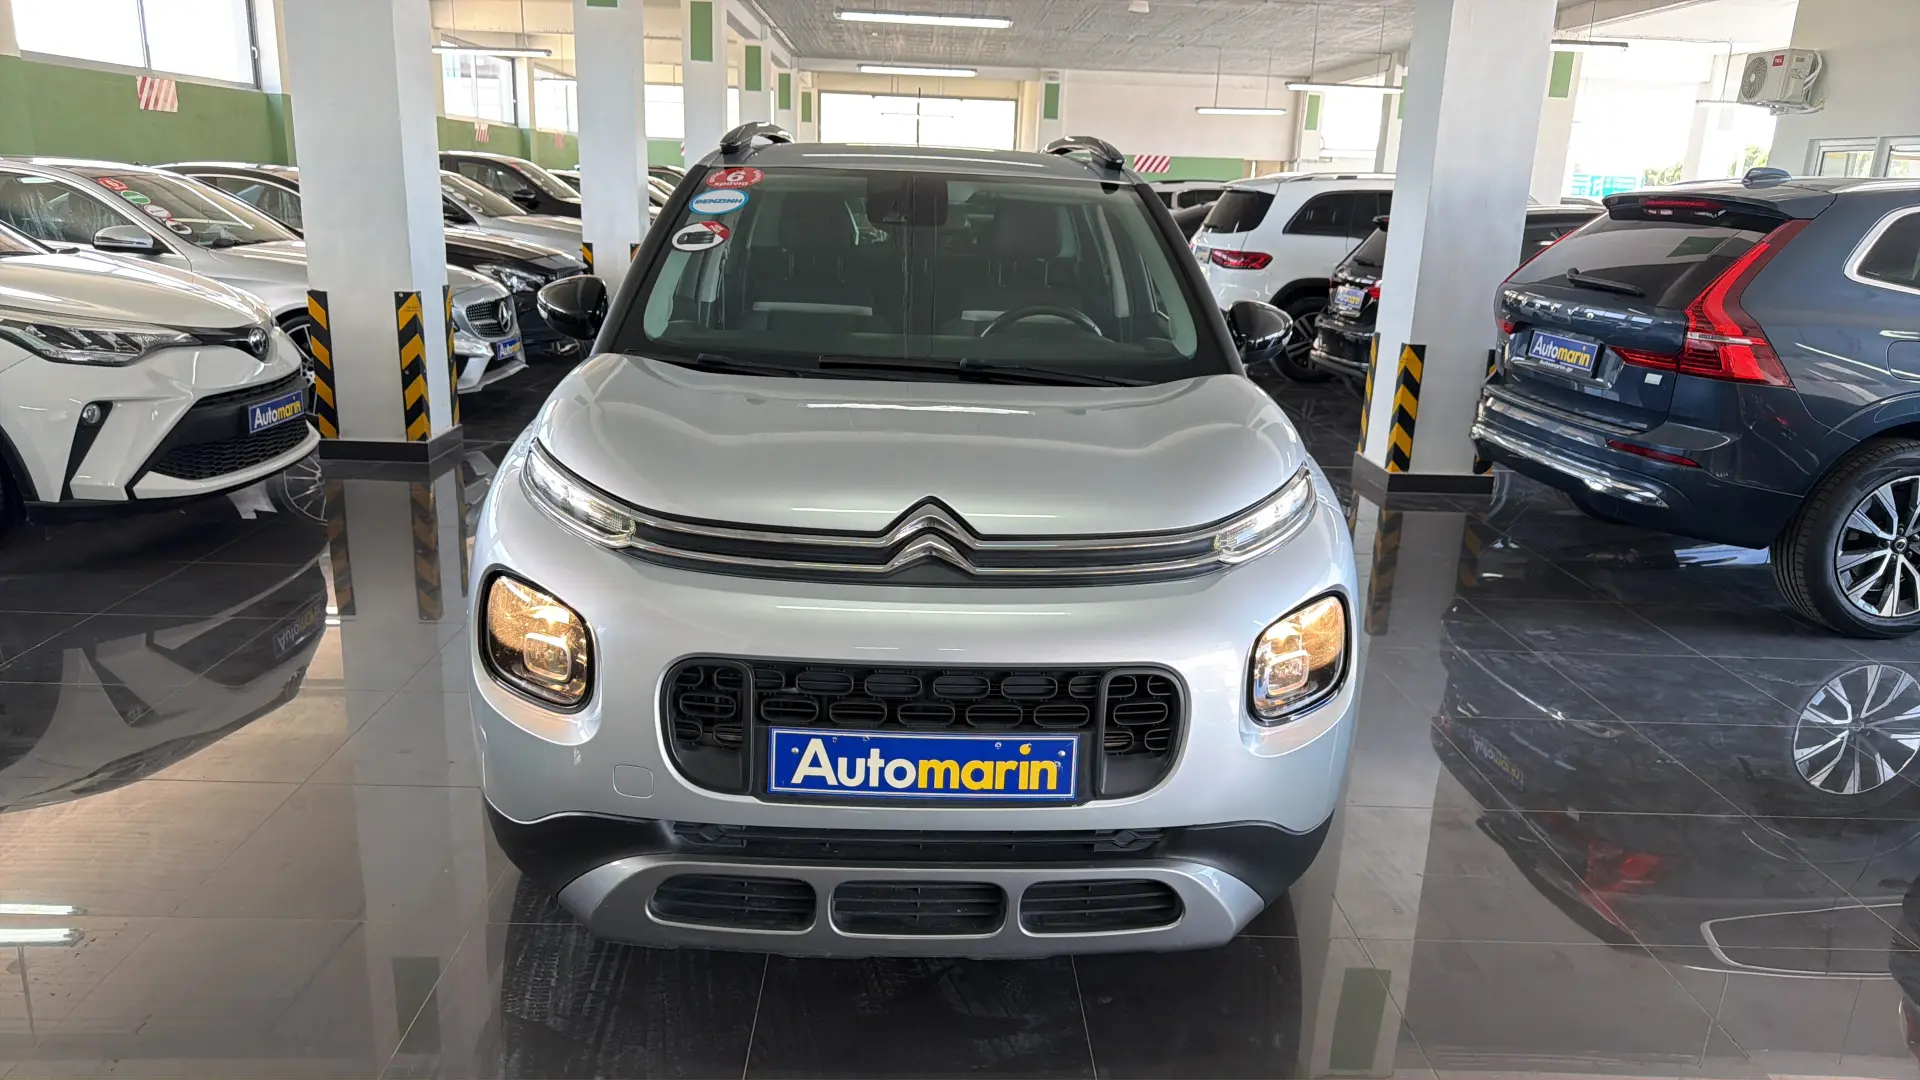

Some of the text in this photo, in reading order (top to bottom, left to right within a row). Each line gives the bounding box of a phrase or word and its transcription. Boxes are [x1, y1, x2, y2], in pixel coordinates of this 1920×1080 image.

[727, 170, 746, 182] 6
[1532, 335, 1591, 367] Automarin
[254, 396, 301, 429] Automarin
[791, 738, 1058, 791] Automarin
